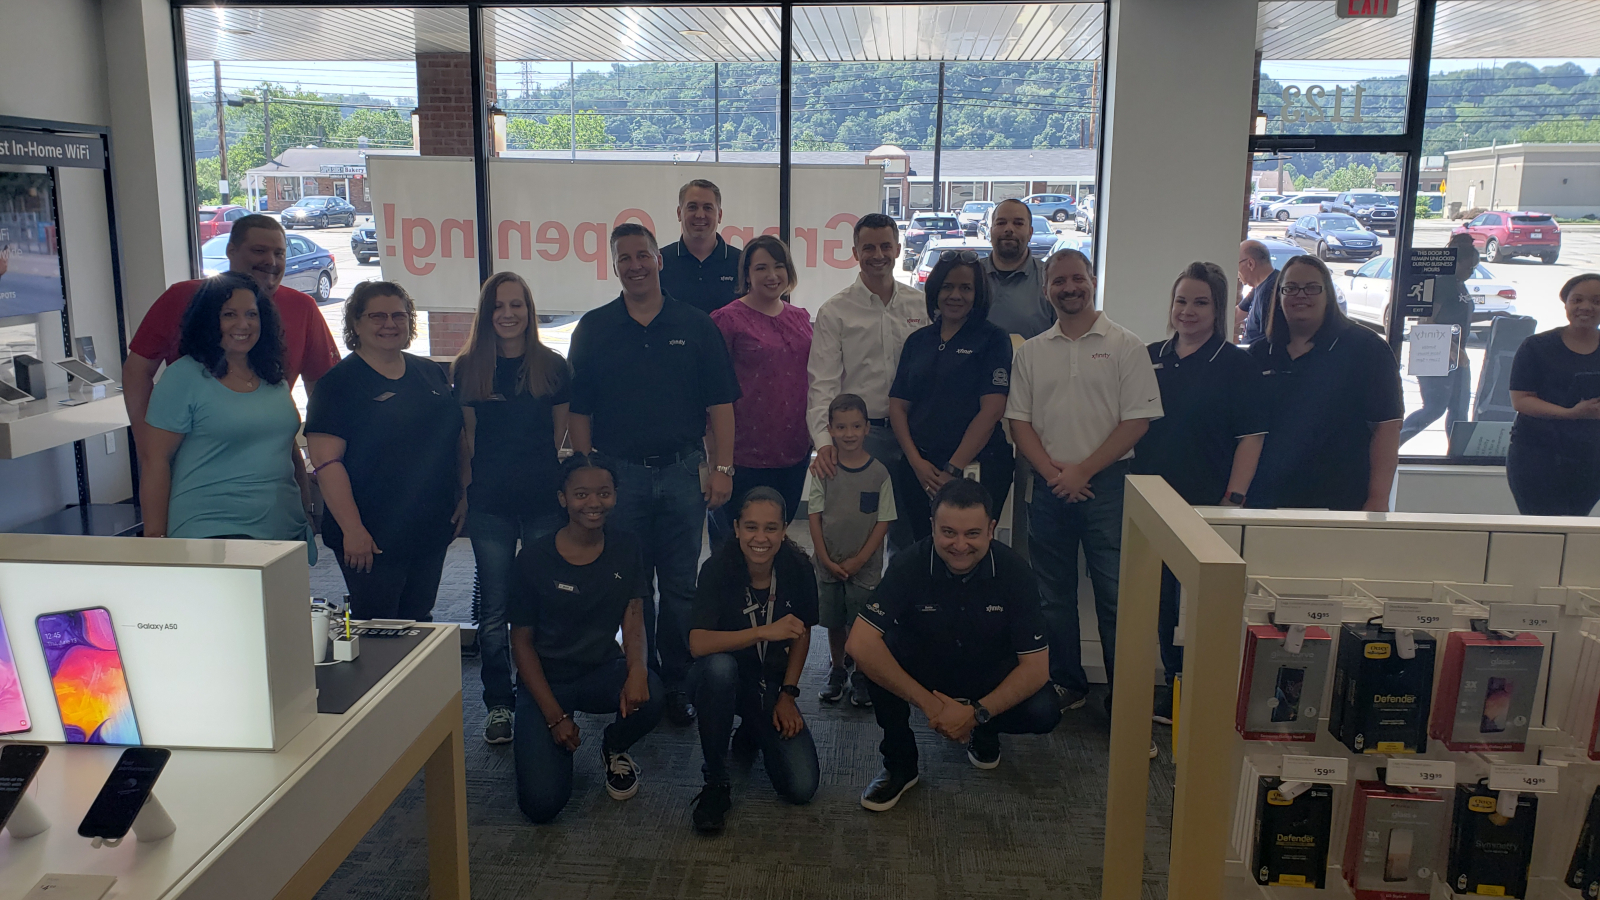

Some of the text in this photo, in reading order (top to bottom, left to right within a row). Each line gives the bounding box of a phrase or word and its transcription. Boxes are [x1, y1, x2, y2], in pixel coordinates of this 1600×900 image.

[12, 140, 63, 158] In-Home
[64, 143, 90, 160] WiFi
[1091, 352, 1111, 360] xfinity
[137, 622, 178, 631] Galaxy A50
[44, 631, 62, 640] 12:45
[1373, 694, 1418, 704] Defender
[1276, 833, 1315, 843] Defender
